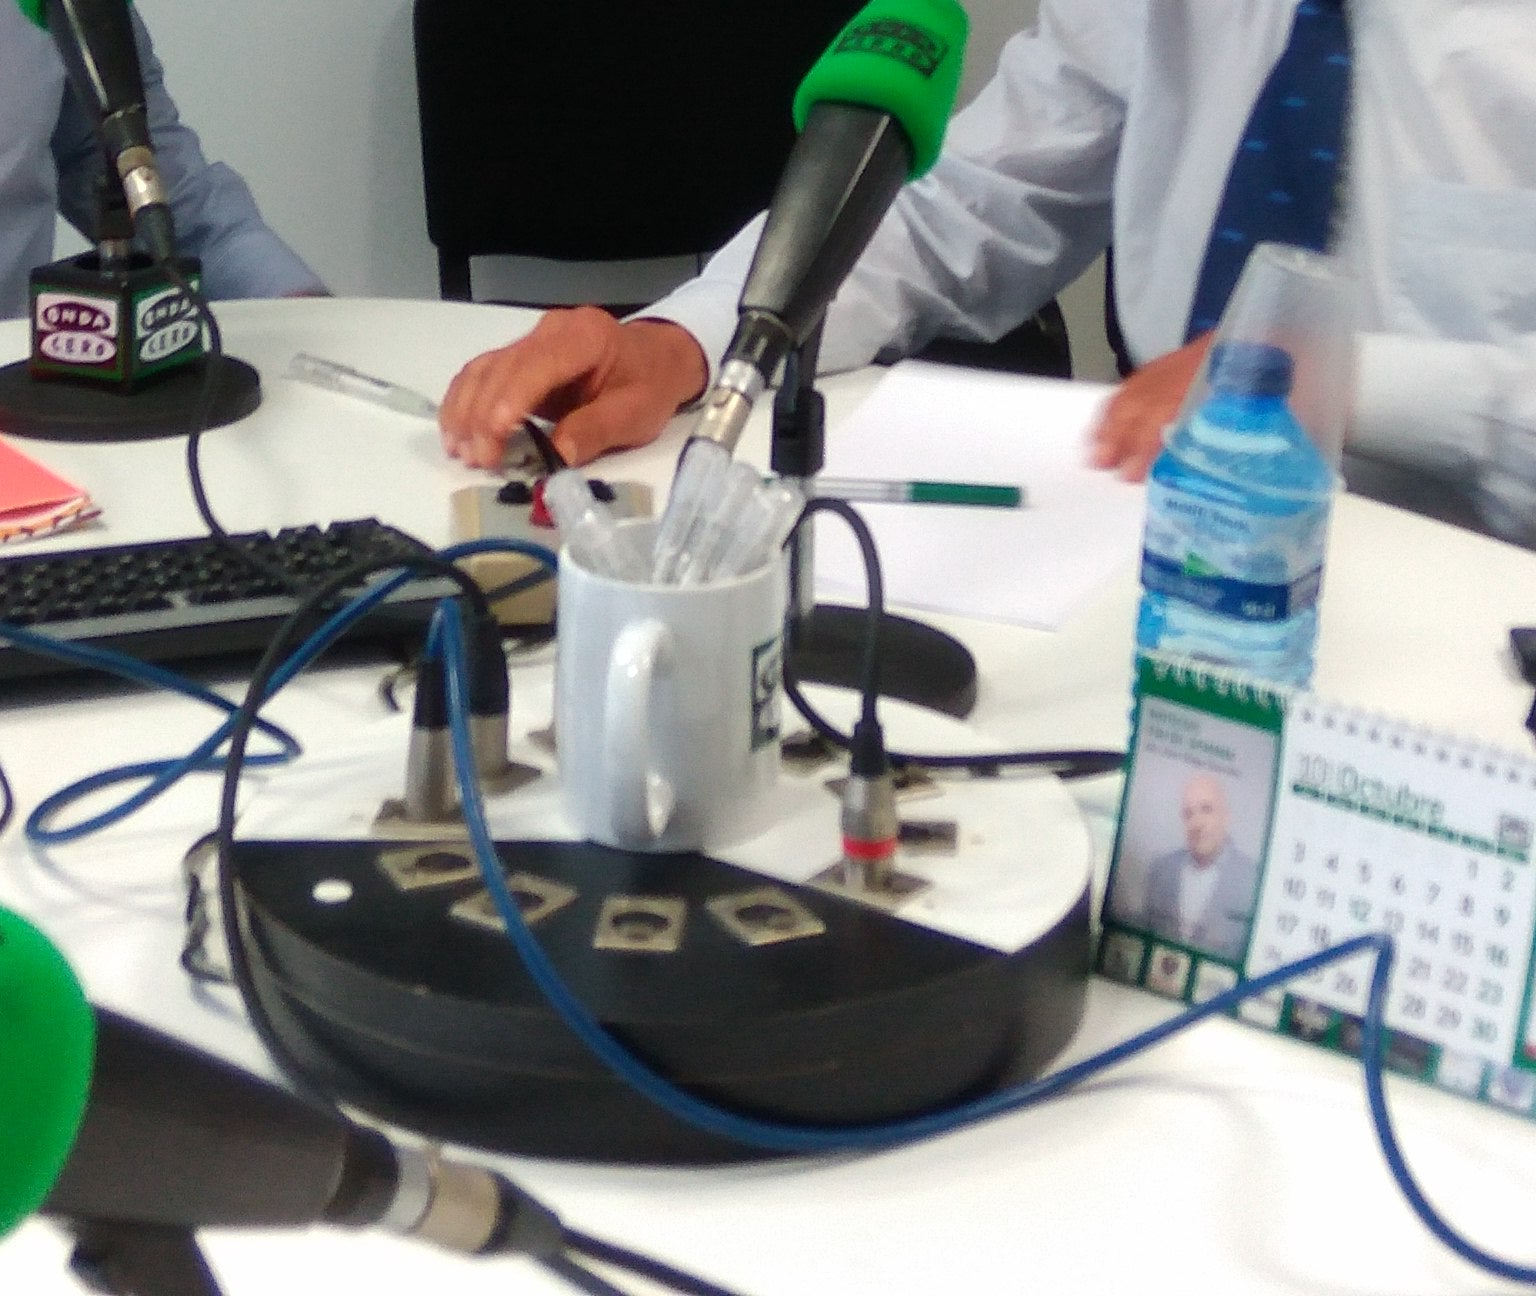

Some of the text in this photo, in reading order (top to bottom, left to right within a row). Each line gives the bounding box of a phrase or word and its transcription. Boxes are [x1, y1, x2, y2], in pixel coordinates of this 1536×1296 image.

[46, 307, 105, 329] ONDA
[52, 336, 105, 357] CERO
[1337, 765, 1445, 822] Octubre
